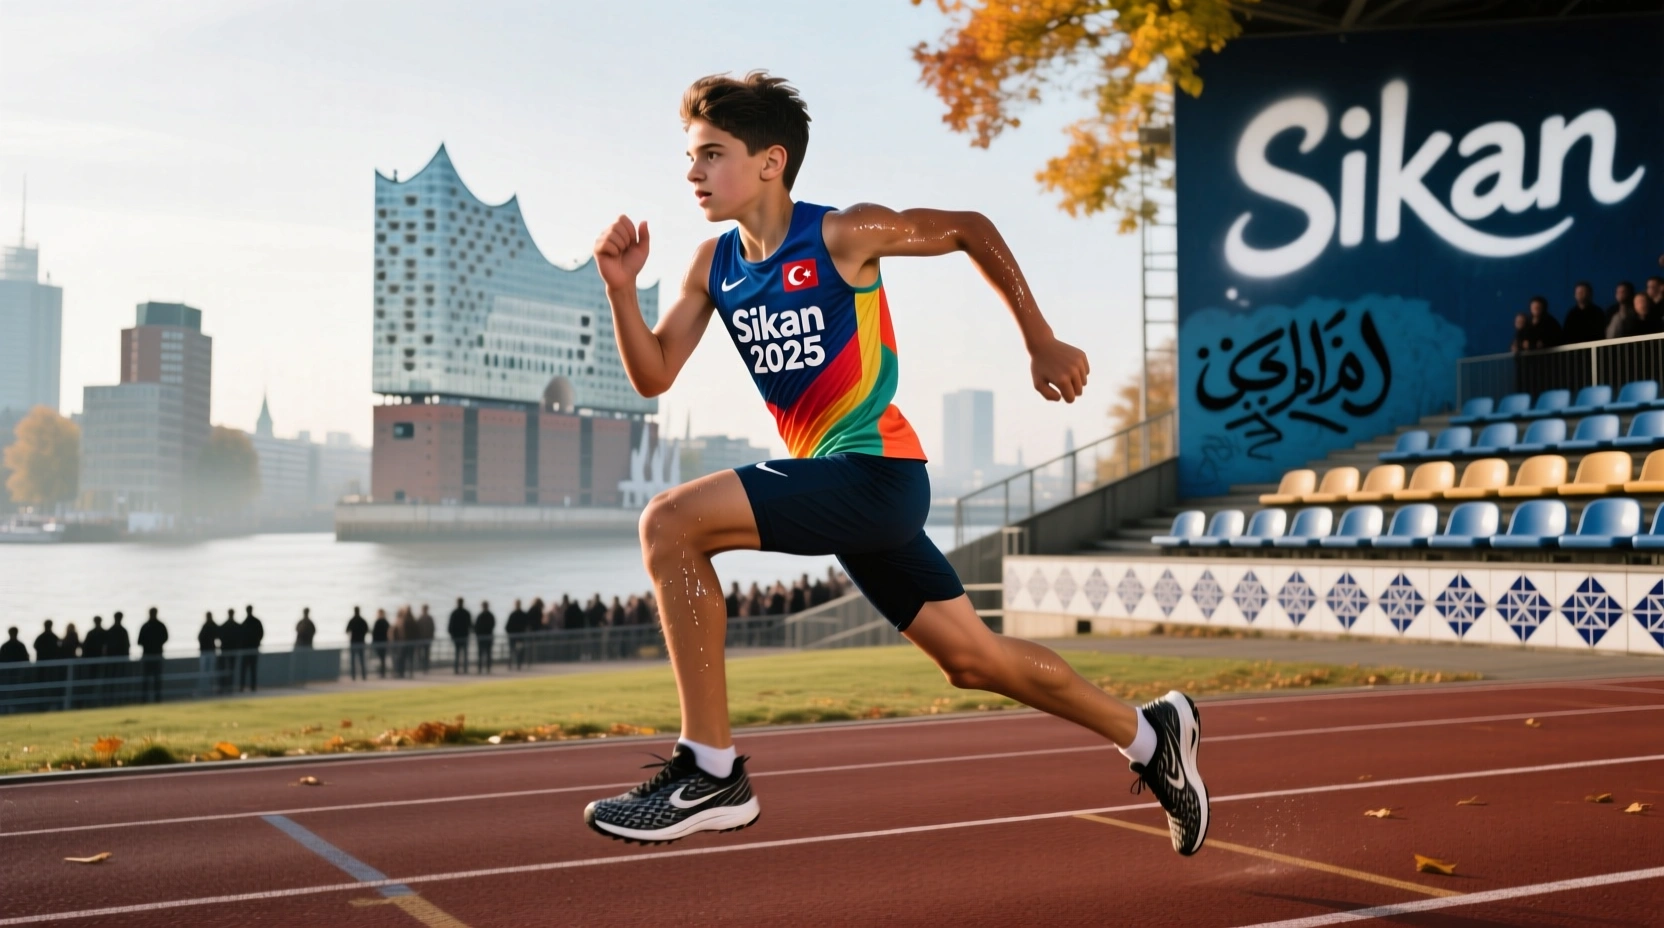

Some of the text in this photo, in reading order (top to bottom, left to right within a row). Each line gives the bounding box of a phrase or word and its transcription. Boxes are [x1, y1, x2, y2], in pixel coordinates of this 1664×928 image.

[1223, 78, 1646, 278] Sikan
[732, 305, 825, 343] Sikan
[750, 334, 826, 374] 2025
